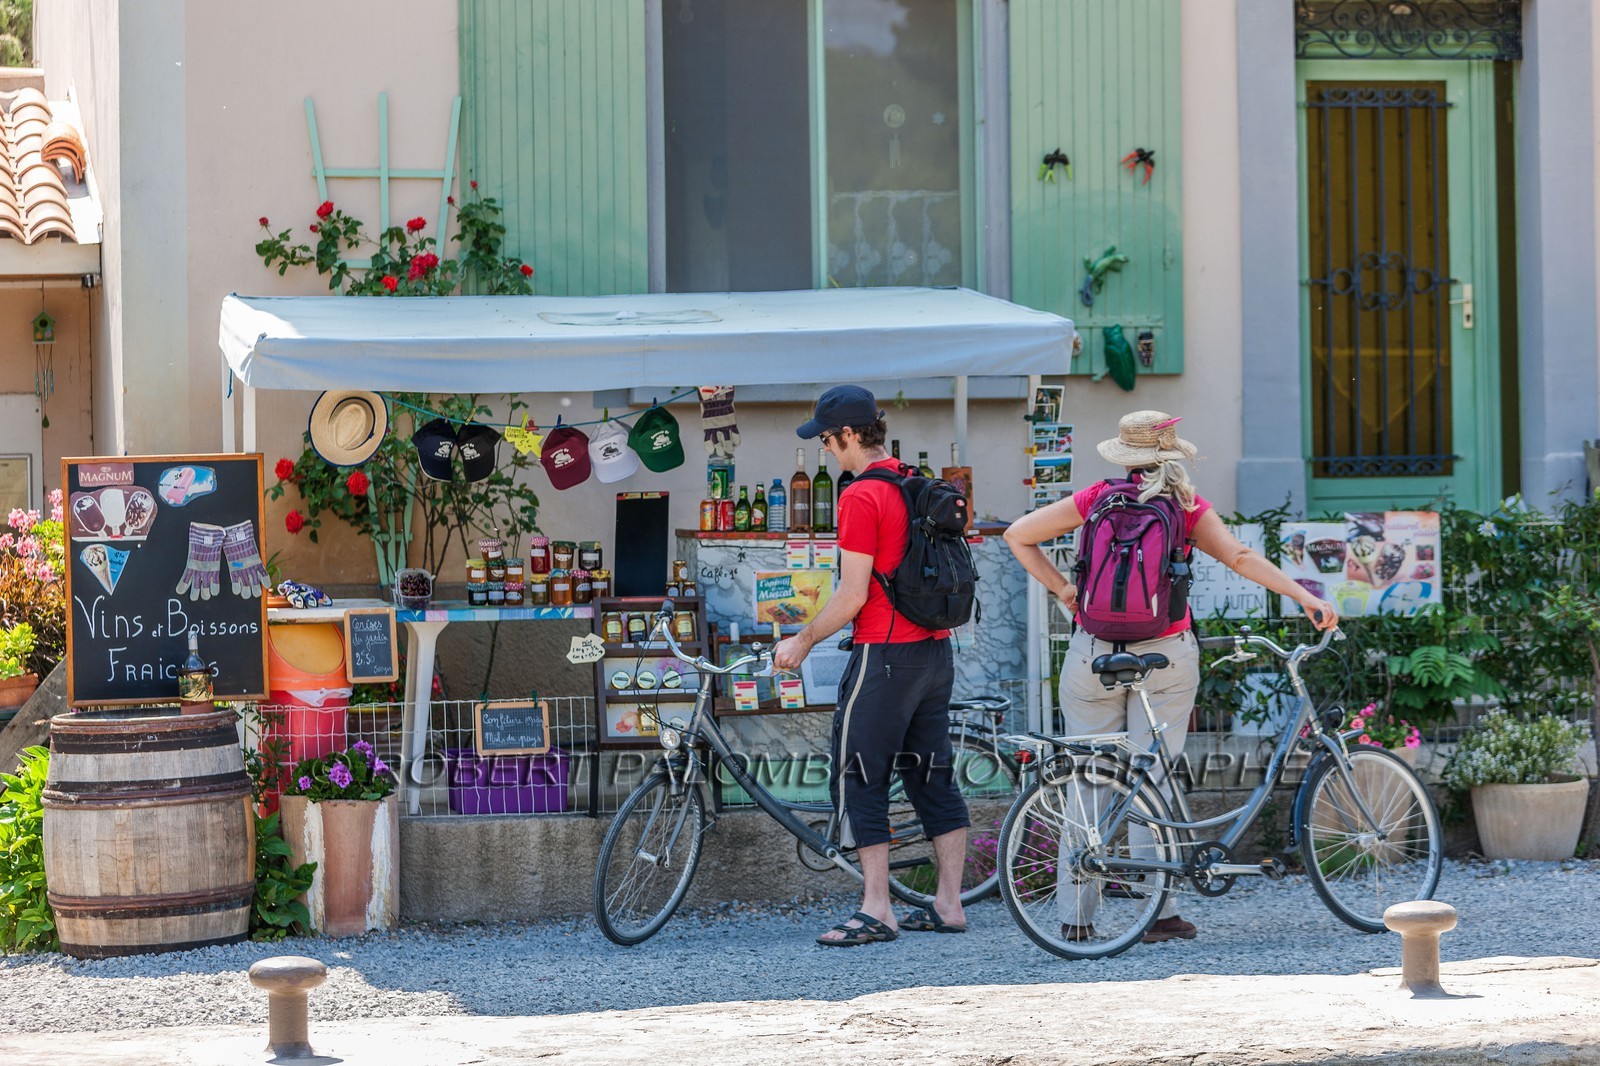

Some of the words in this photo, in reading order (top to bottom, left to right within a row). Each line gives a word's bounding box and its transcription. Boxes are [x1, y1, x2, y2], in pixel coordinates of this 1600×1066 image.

[80, 471, 132, 483] MAGNUM
[701, 566, 723, 583] Café
[758, 587, 793, 600] Muscat
[74, 595, 144, 640] Vins
[151, 623, 164, 637] et
[167, 598, 259, 637] Boissons
